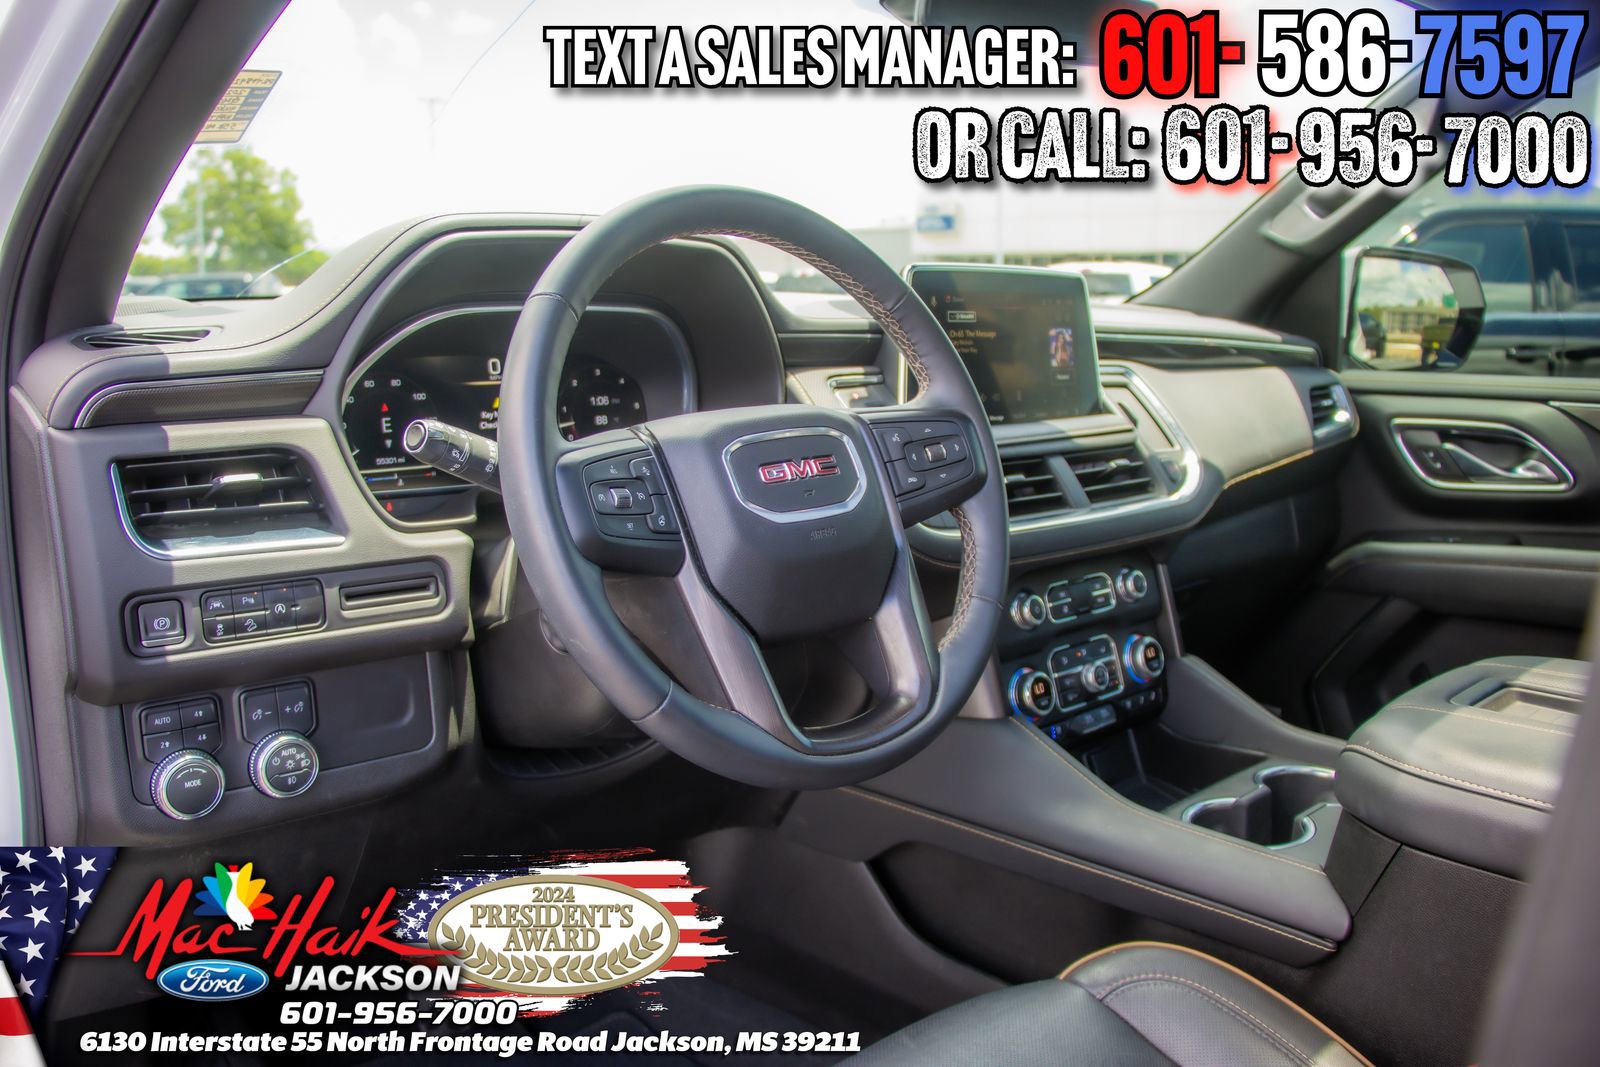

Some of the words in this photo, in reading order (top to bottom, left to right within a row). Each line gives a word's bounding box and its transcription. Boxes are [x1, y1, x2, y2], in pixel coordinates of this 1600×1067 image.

[364, 380, 375, 388] 60
[412, 393, 426, 401] 100
[381, 418, 393, 434] E
[758, 456, 841, 486] GMC
[154, 716, 171, 726] AUTO
[281, 748, 297, 757] AUTO
[184, 778, 202, 788] MODE
